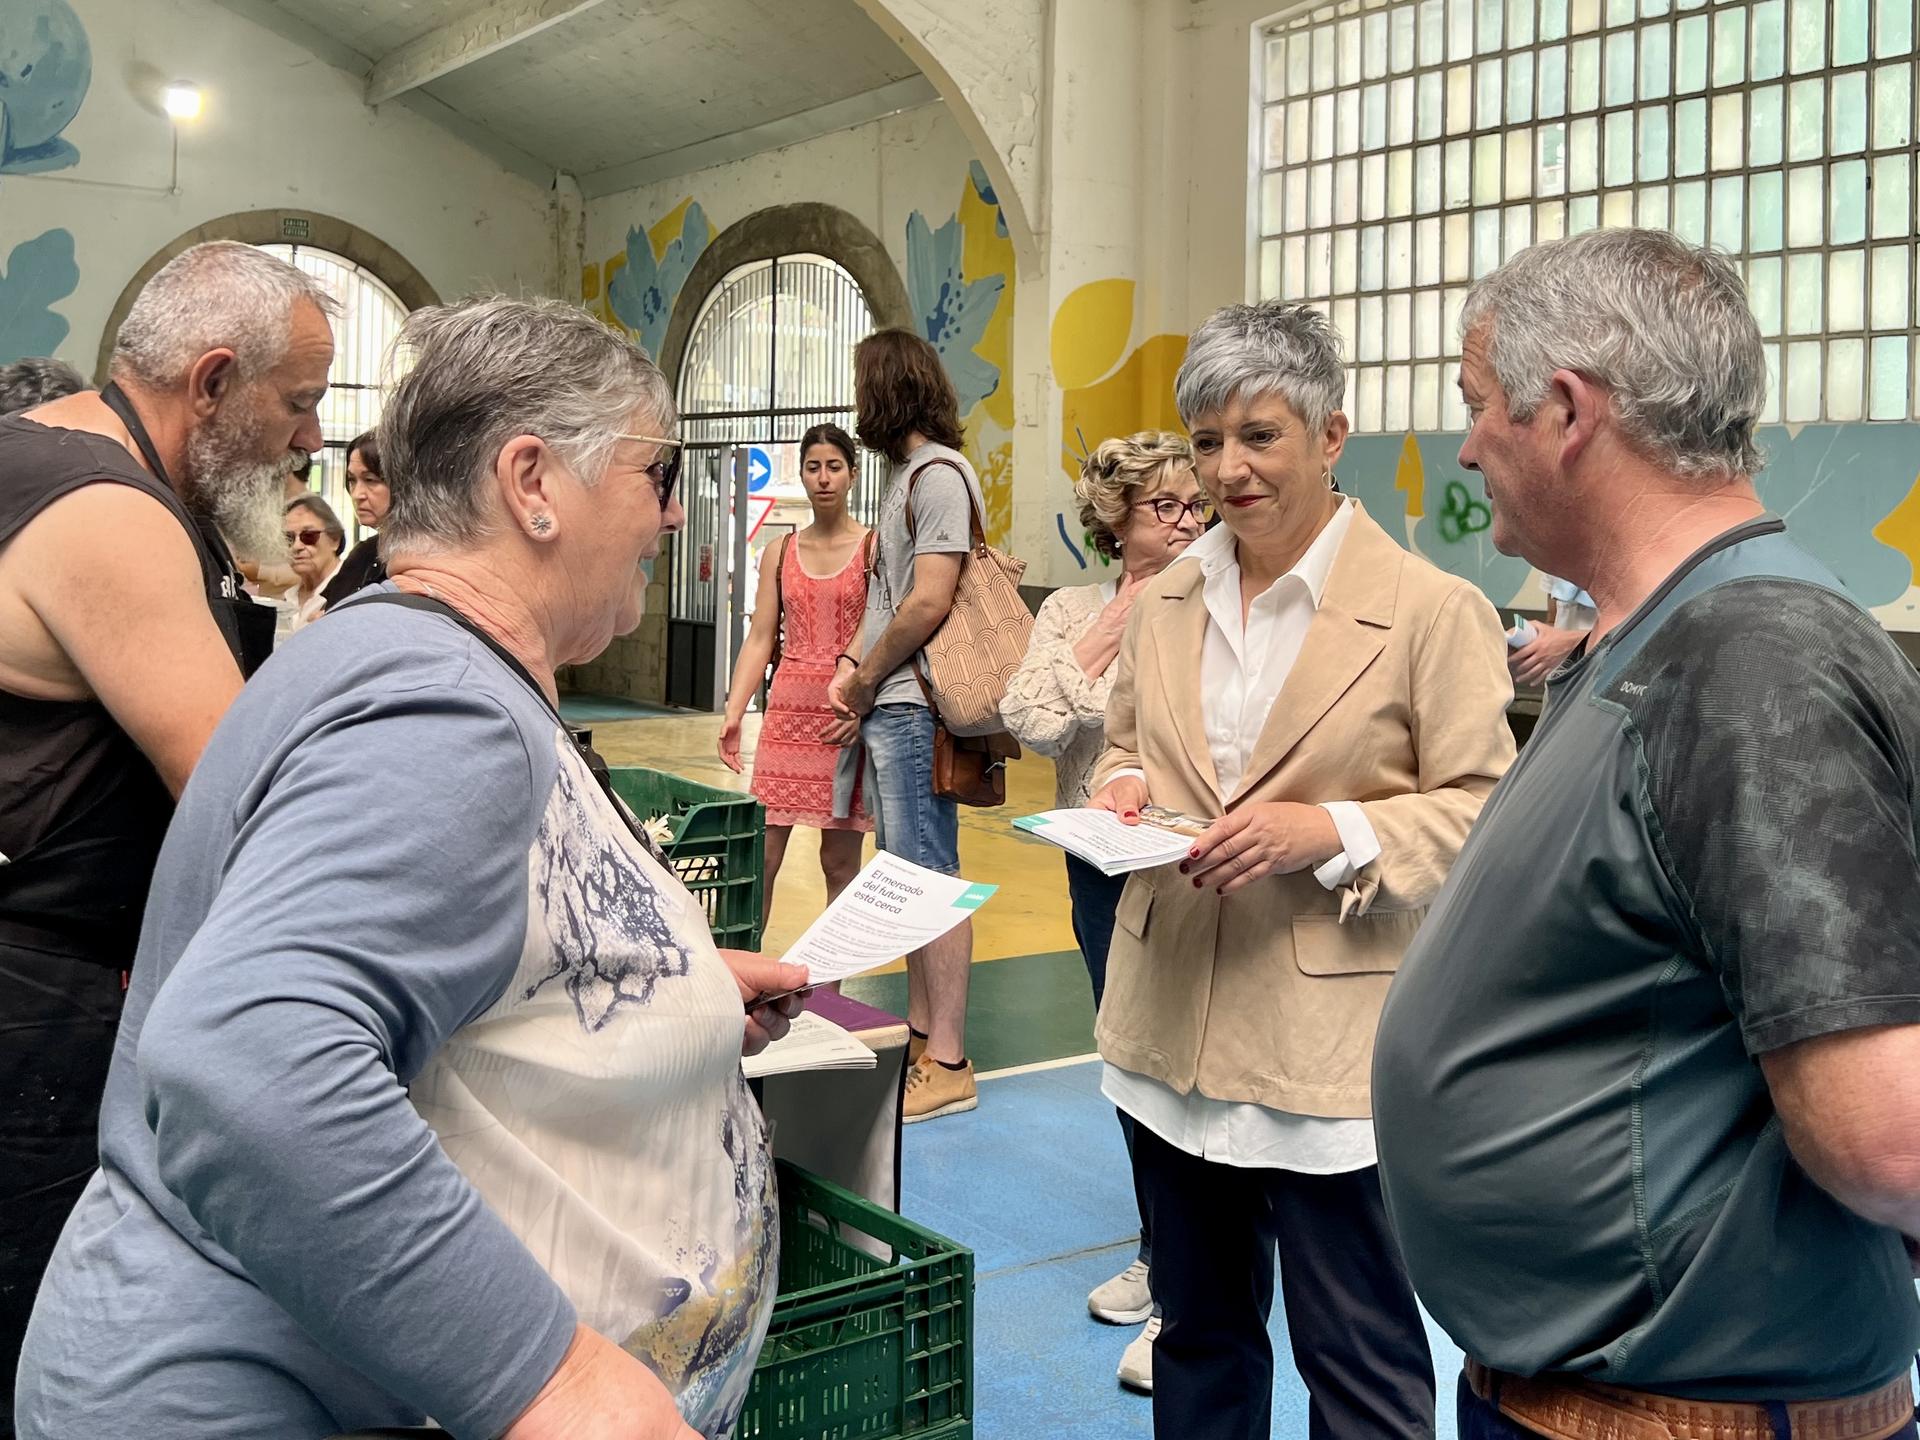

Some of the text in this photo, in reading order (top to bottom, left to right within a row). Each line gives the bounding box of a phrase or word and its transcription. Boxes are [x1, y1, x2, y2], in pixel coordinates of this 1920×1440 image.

[862, 881, 907, 904] del futuro
[871, 869, 924, 896] El mercado
[853, 890, 903, 914] está cerca
